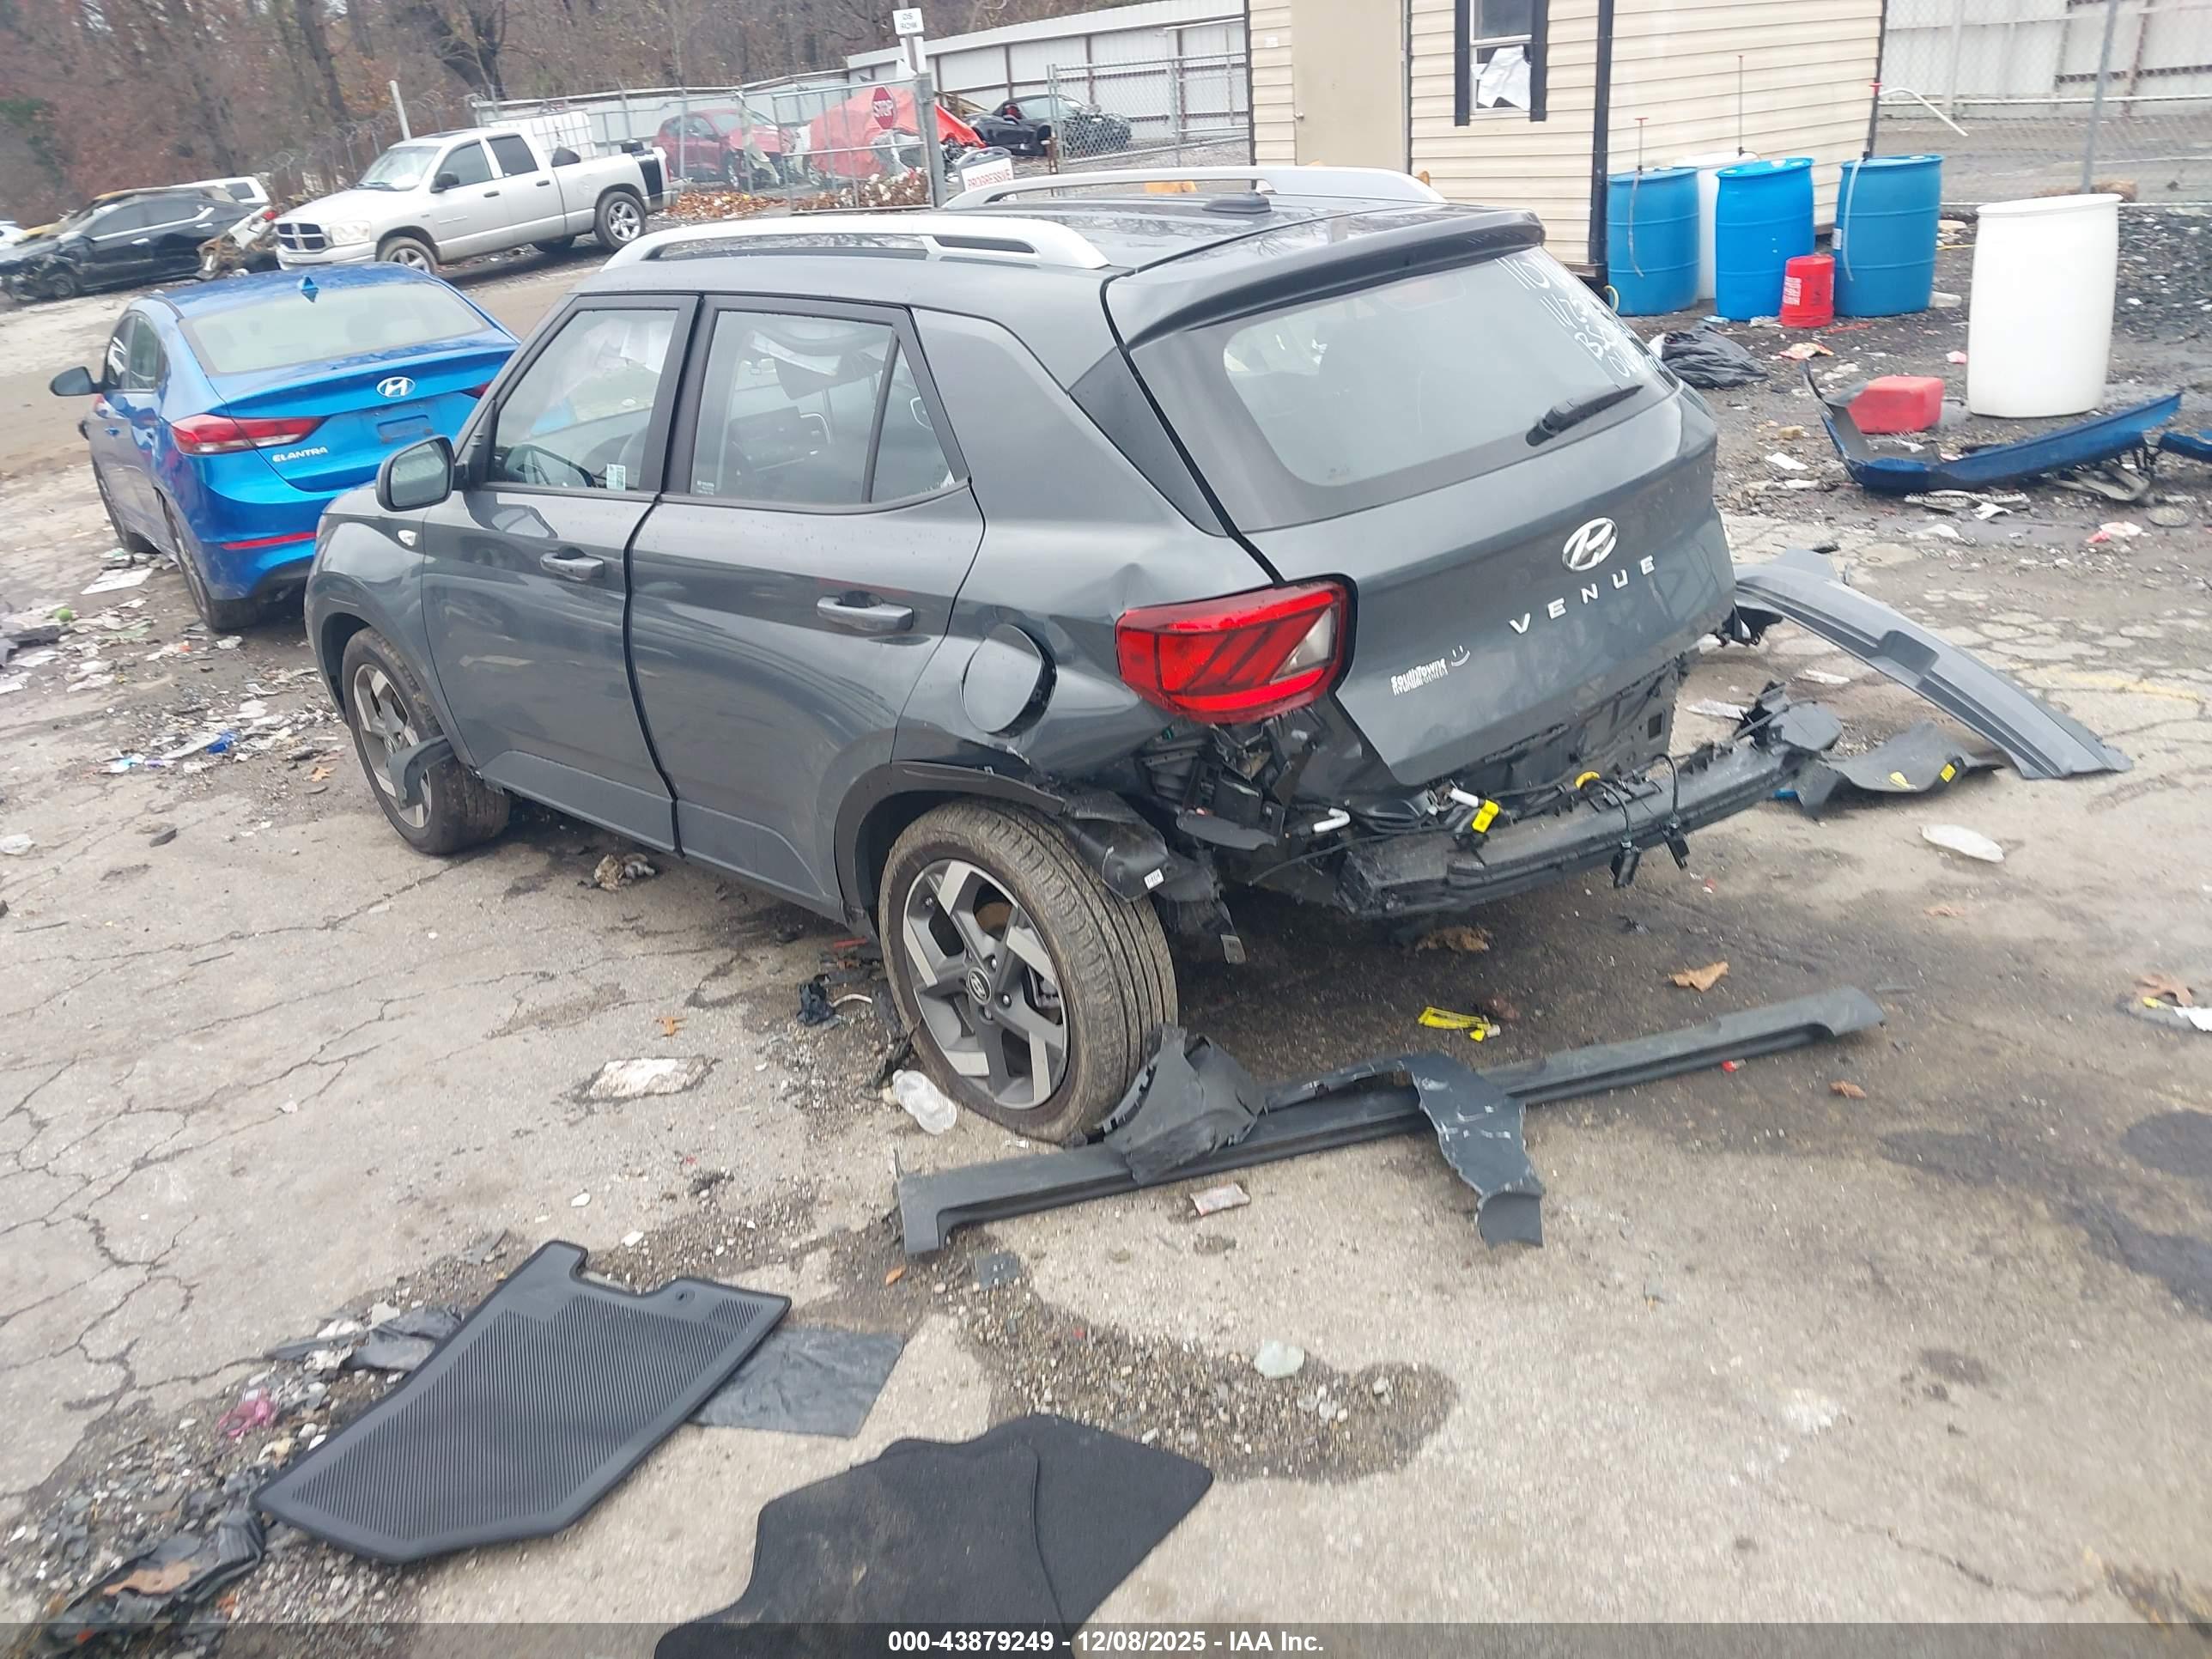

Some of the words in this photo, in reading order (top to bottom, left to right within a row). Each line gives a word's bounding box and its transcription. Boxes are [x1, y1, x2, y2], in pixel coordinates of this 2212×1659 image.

[872, 100, 894, 118] STOP
[272, 446, 328, 463] ELANTRA
[1508, 554, 1656, 635] VENUE
